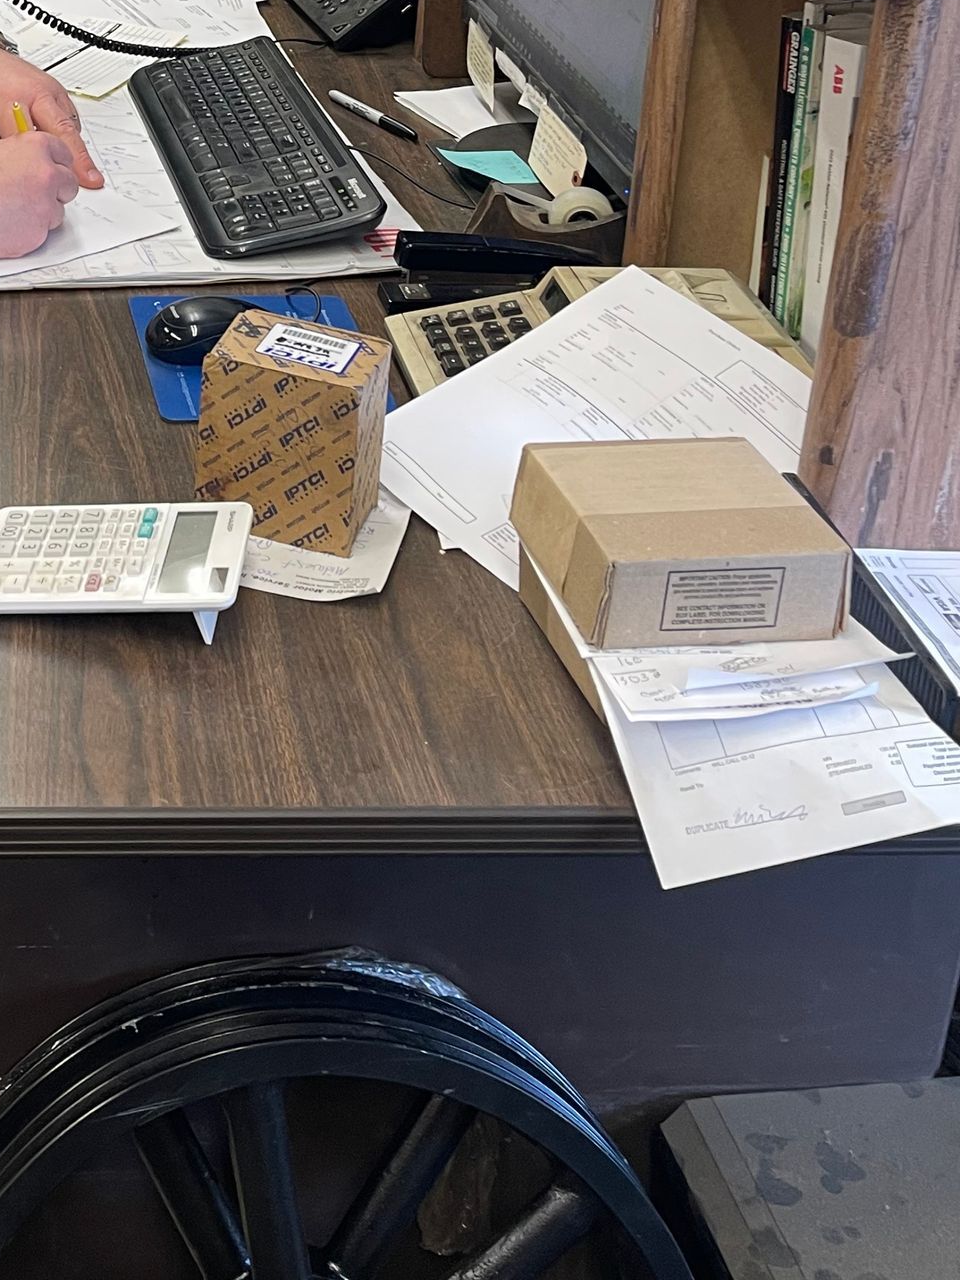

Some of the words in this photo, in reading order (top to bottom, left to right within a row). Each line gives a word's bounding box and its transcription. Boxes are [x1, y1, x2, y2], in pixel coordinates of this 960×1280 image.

[786, 31, 800, 94] GRAINGER
[833, 65, 845, 94] ABB
[264, 347, 338, 369] IPTCI
[224, 397, 268, 430] IPTCI
[279, 416, 321, 449] IPTCI
[232, 450, 274, 483] IPTCI
[283, 470, 326, 503] IPTCI
[86, 511, 100, 520] 7
[1, 527, 18, 537] 00
[27, 527, 43, 535] 2
[54, 527, 69, 535] 5
[79, 526, 95, 534] 8
[48, 542, 63, 551] 6
[74, 542, 89, 550] 9
[293, 584, 324, 594] Motor
[685, 820, 729, 835] DUPLICATE
